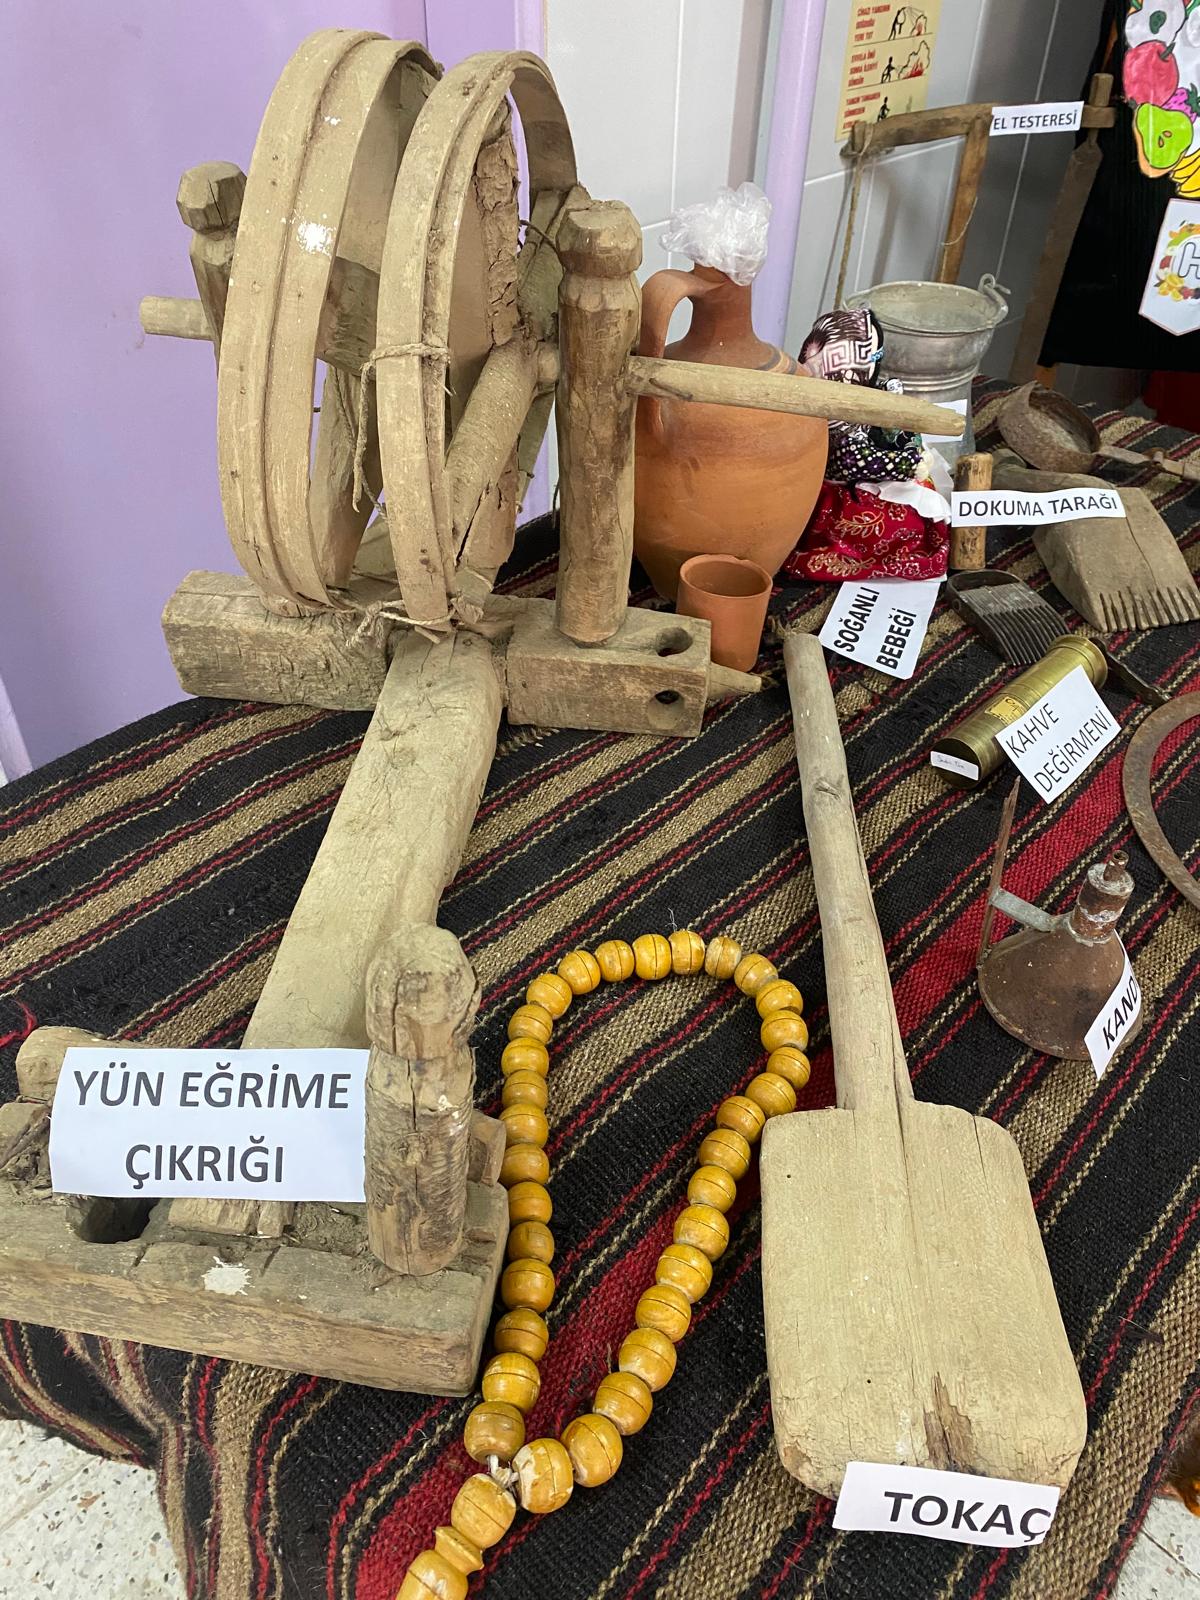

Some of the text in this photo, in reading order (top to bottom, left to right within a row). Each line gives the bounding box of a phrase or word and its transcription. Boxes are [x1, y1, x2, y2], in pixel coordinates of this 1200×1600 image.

[993, 109, 1078, 130] EL TESTERESİ
[959, 493, 1118, 517] DOKUMA TARAĞI
[833, 586, 880, 653] SOĞANLI
[876, 607, 917, 670] BEBEĞİ
[1005, 702, 1060, 759] KAHVE
[1033, 705, 1112, 793] DEĞİRMENİ
[73, 1062, 352, 1109] YÜN EĞRİME
[125, 1135, 284, 1190] ÇIKRIĞI
[884, 1491, 1052, 1543] TOKAÇ
